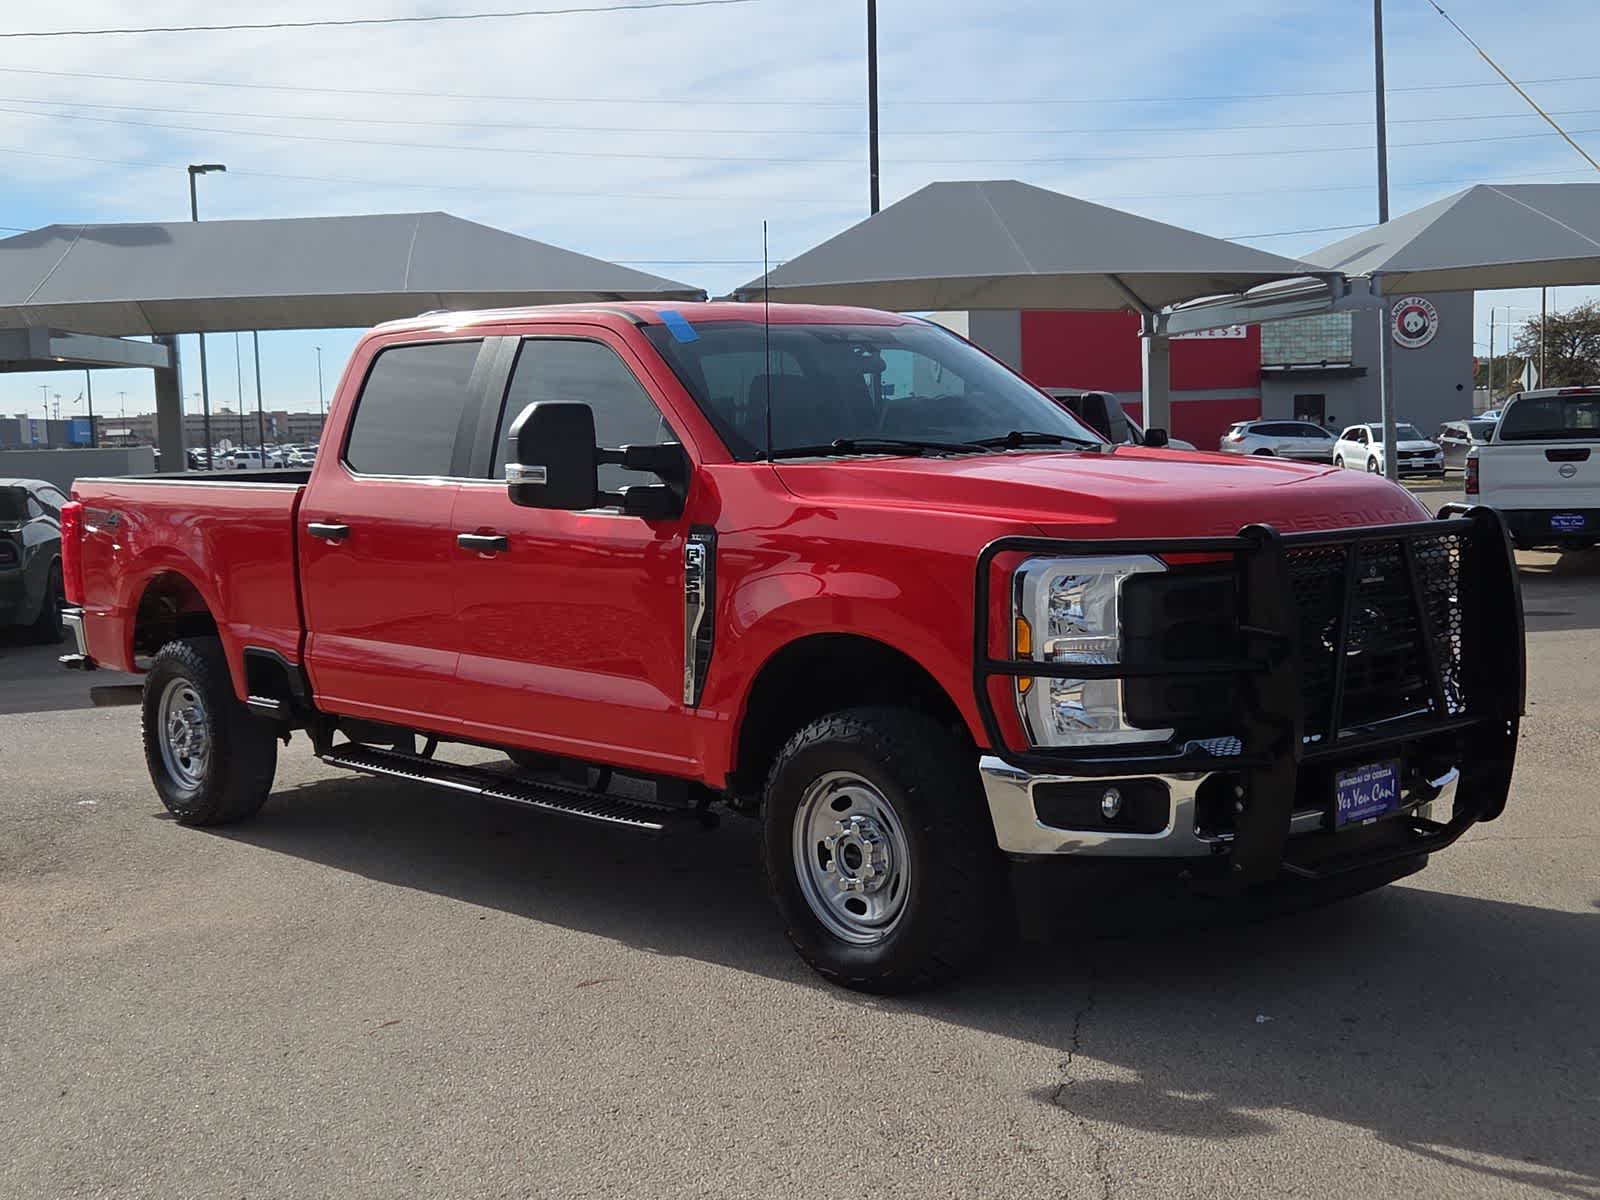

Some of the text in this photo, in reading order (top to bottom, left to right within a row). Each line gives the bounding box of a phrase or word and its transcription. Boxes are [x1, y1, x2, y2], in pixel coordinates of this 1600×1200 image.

[1337, 791, 1351, 812] Yes
[1352, 787, 1370, 808] You
[1371, 778, 1395, 802] Can!
